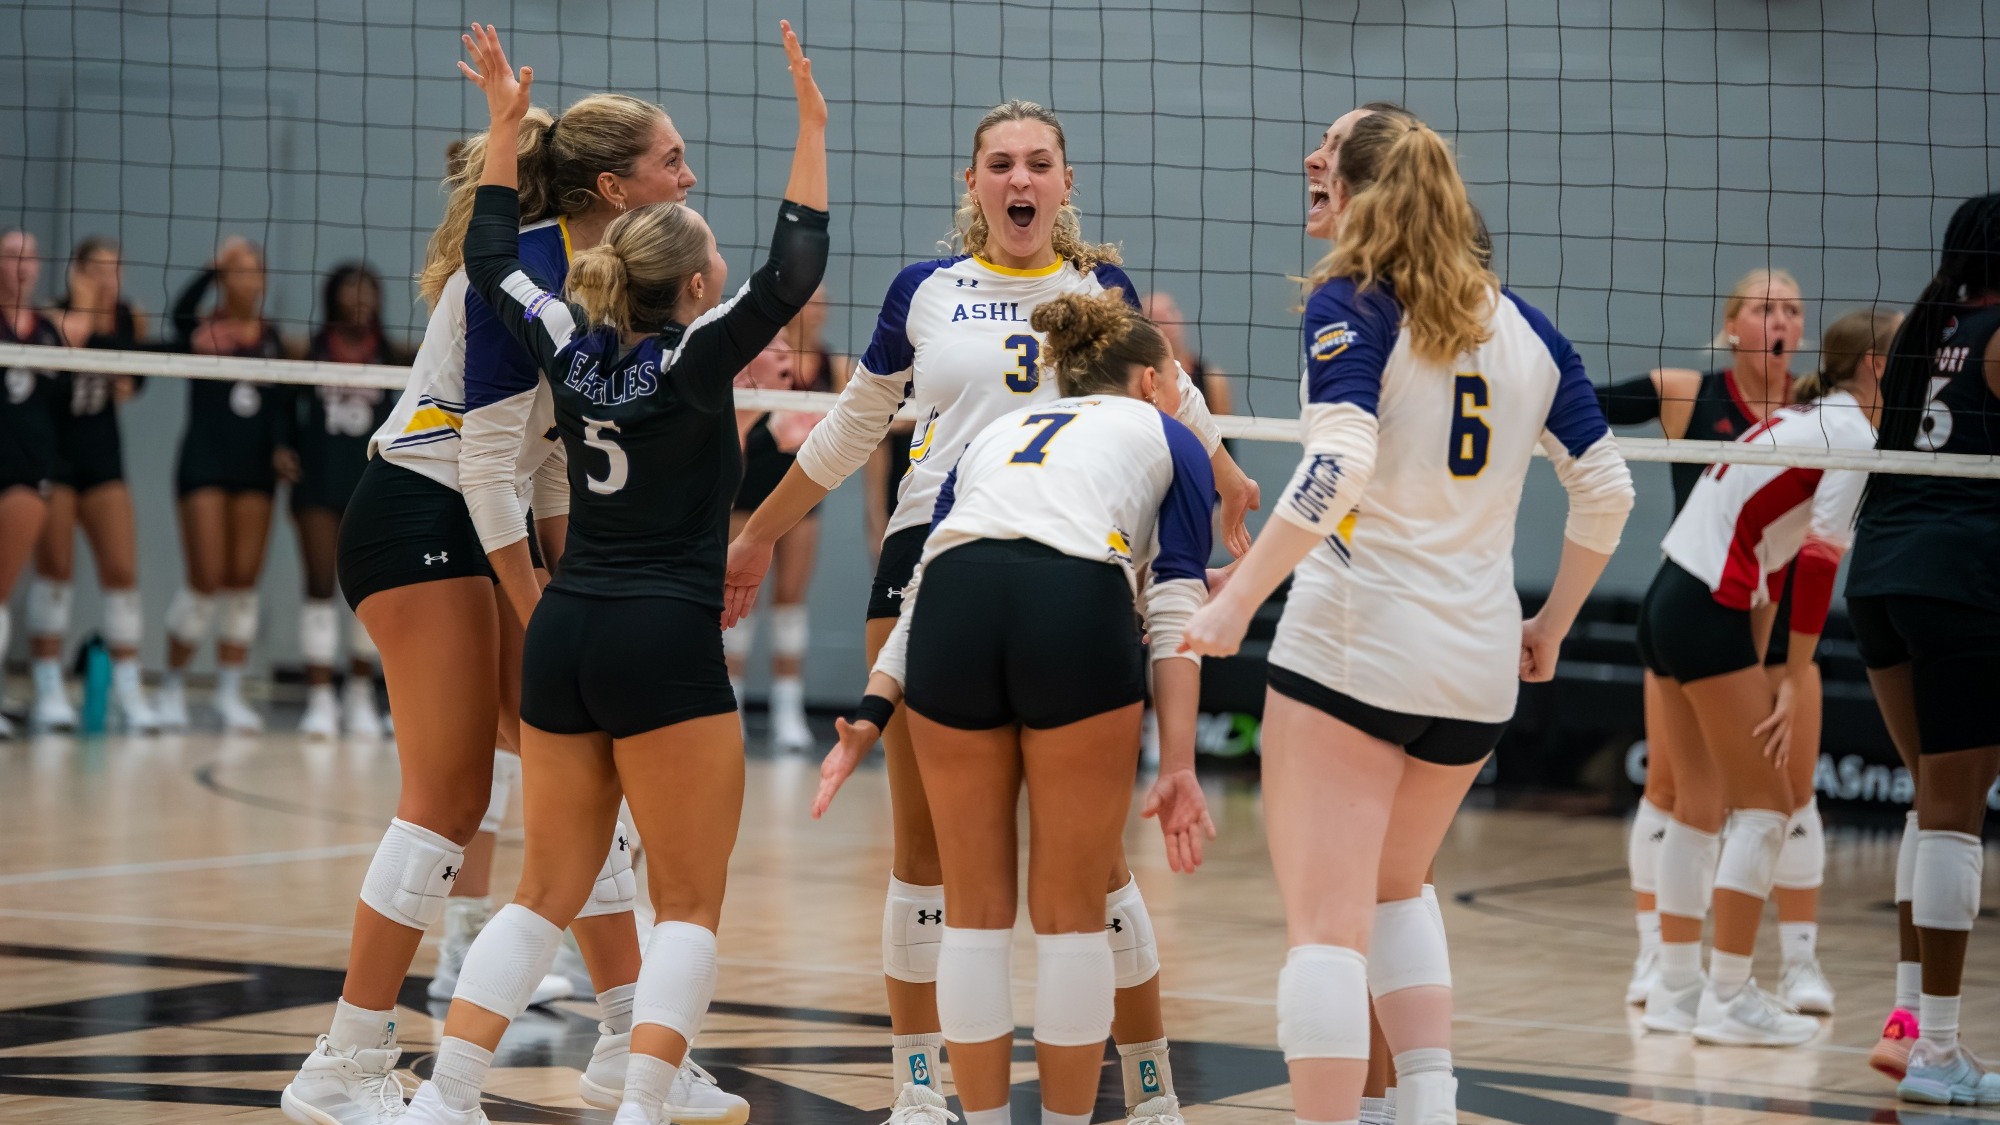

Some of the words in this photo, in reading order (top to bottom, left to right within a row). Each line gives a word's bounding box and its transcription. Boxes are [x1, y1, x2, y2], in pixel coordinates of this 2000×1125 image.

[951, 302, 1028, 323] ASHL
[1003, 333, 1042, 395] 3
[582, 415, 629, 494] 5
[1006, 412, 1083, 467] 7
[1447, 372, 1493, 480] 6
[1812, 752, 1916, 804] ASna
